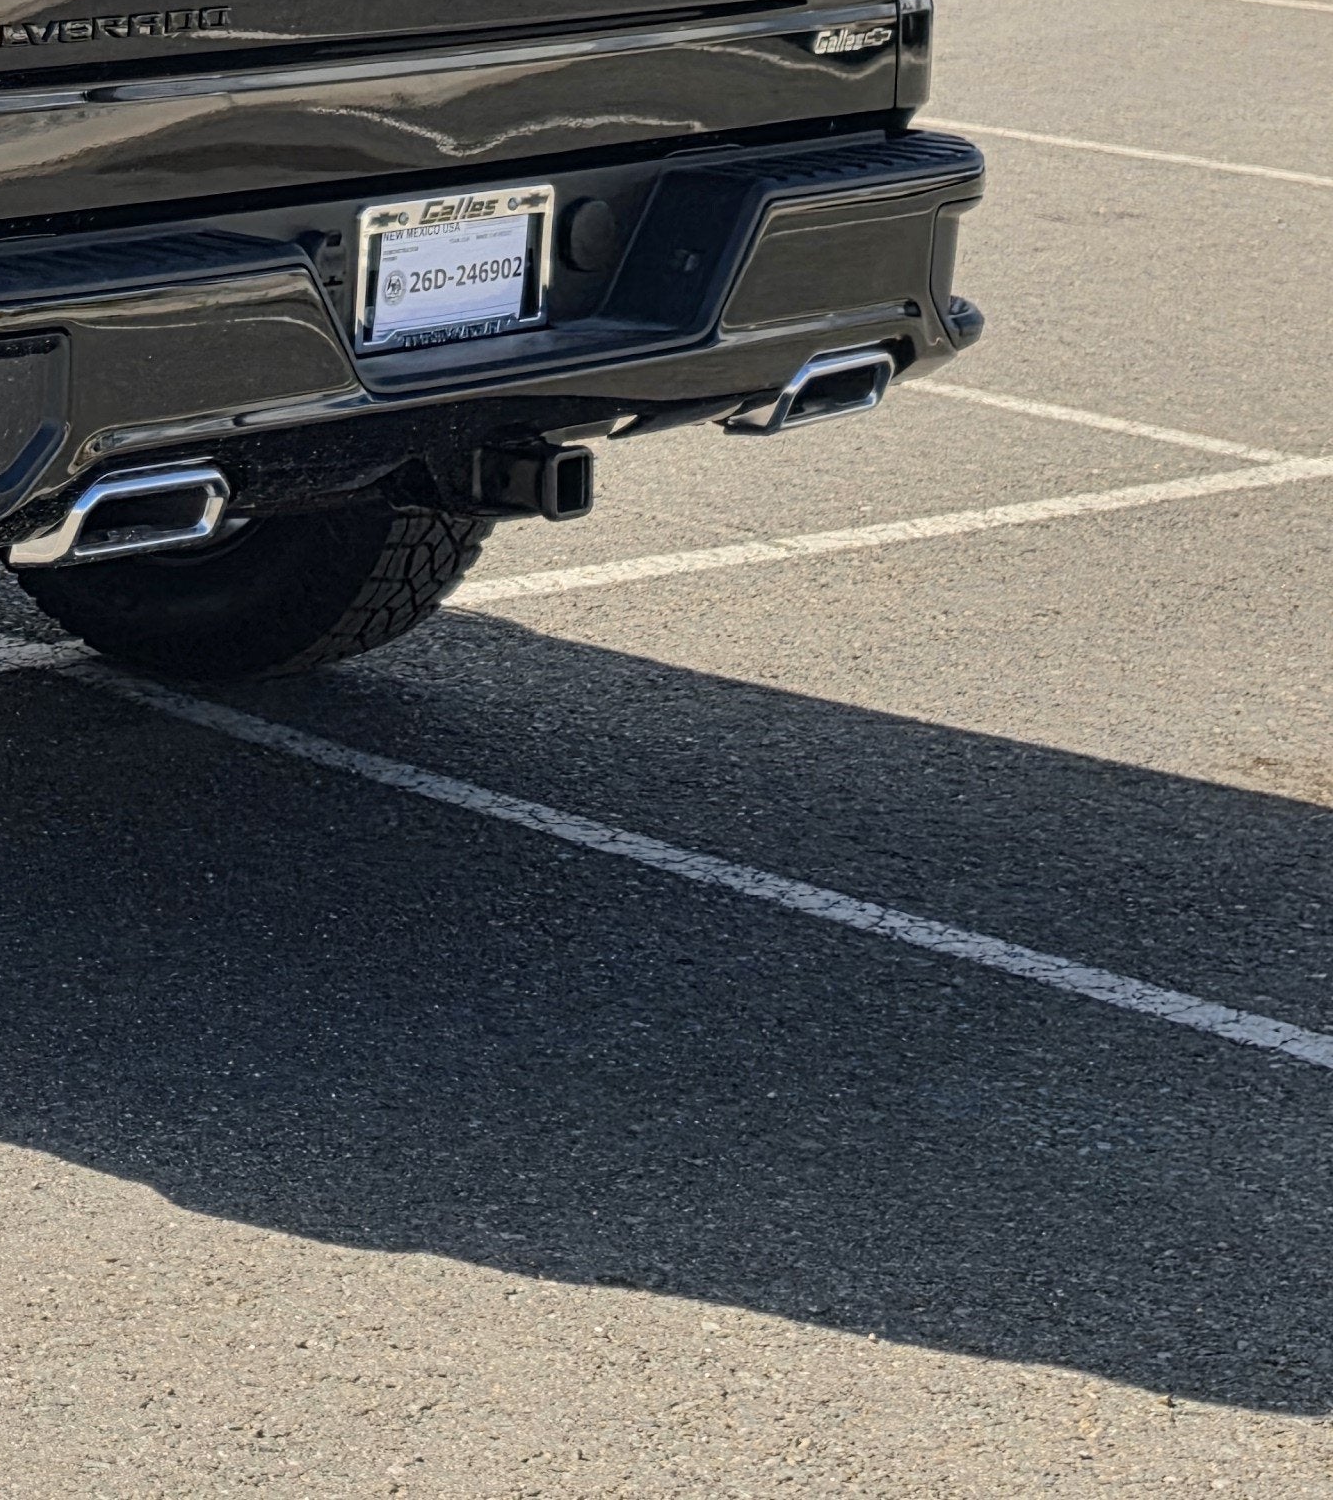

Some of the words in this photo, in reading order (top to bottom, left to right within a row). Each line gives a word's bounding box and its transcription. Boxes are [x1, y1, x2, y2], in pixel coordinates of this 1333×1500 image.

[419, 196, 499, 225] Galles
[383, 228, 404, 242] NEW
[406, 224, 440, 239] MEXICO
[442, 221, 461, 234] USA
[409, 256, 523, 293] 26D-246902
